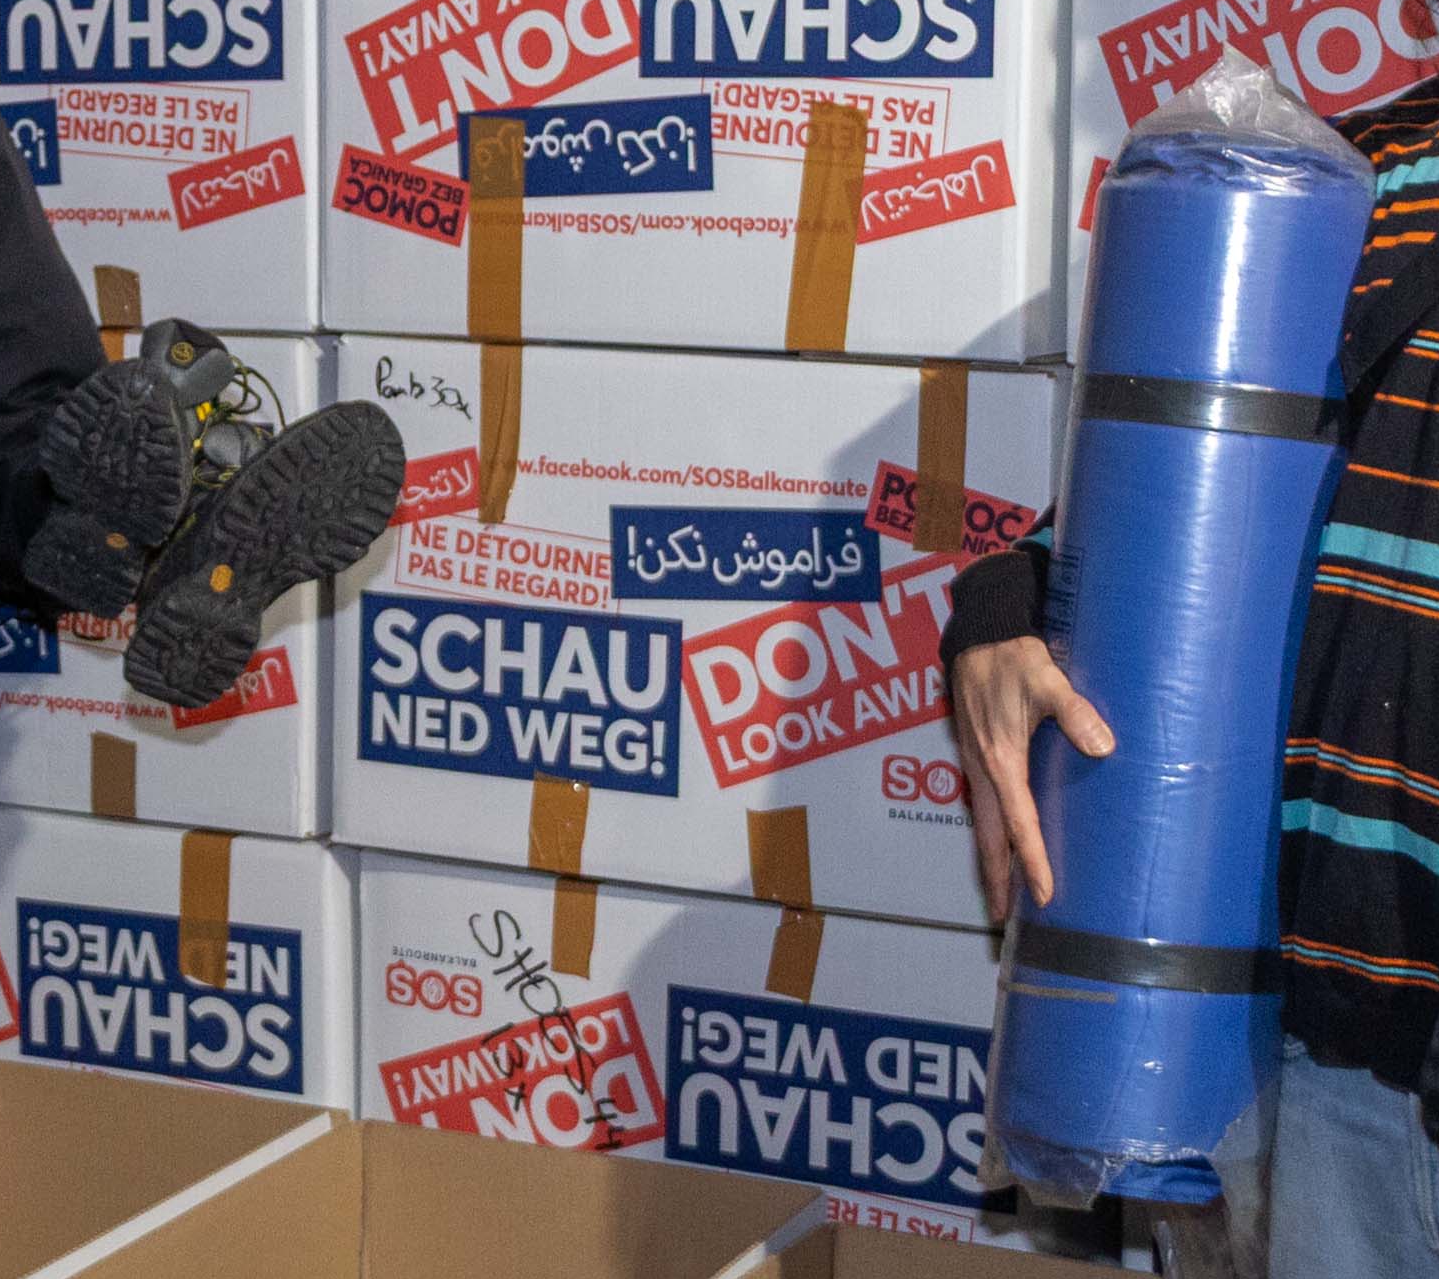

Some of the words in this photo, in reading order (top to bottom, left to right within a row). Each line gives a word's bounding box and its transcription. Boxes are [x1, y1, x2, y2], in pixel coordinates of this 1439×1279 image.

[59, 88, 157, 116] REGARD!
[165, 96, 189, 120] LE
[196, 99, 239, 123] PAS
[884, 94, 936, 124] PAS
[57, 117, 193, 158] DÉTOURNE
[206, 131, 237, 154] NE
[349, 158, 415, 197] GRANICA
[423, 179, 466, 205] BEZ
[342, 184, 461, 237] POMOĆ
[410, 522, 446, 550] NE
[457, 522, 611, 579] DÉTOURNE
[408, 555, 451, 581] PAS
[459, 563, 489, 587] LE
[495, 571, 610, 609] REGARD!
[370, 608, 669, 710] SCHAU
[371, 691, 491, 755] NED
[505, 706, 666, 775] WEG!
[717, 705, 847, 774] LOOK
[27, 918, 163, 982] WEG!
[391, 945, 478, 969] BALKANROUTE
[386, 958, 484, 1018] SOS
[30, 974, 291, 1076] SCHAU
[680, 1006, 848, 1086] WEG!
